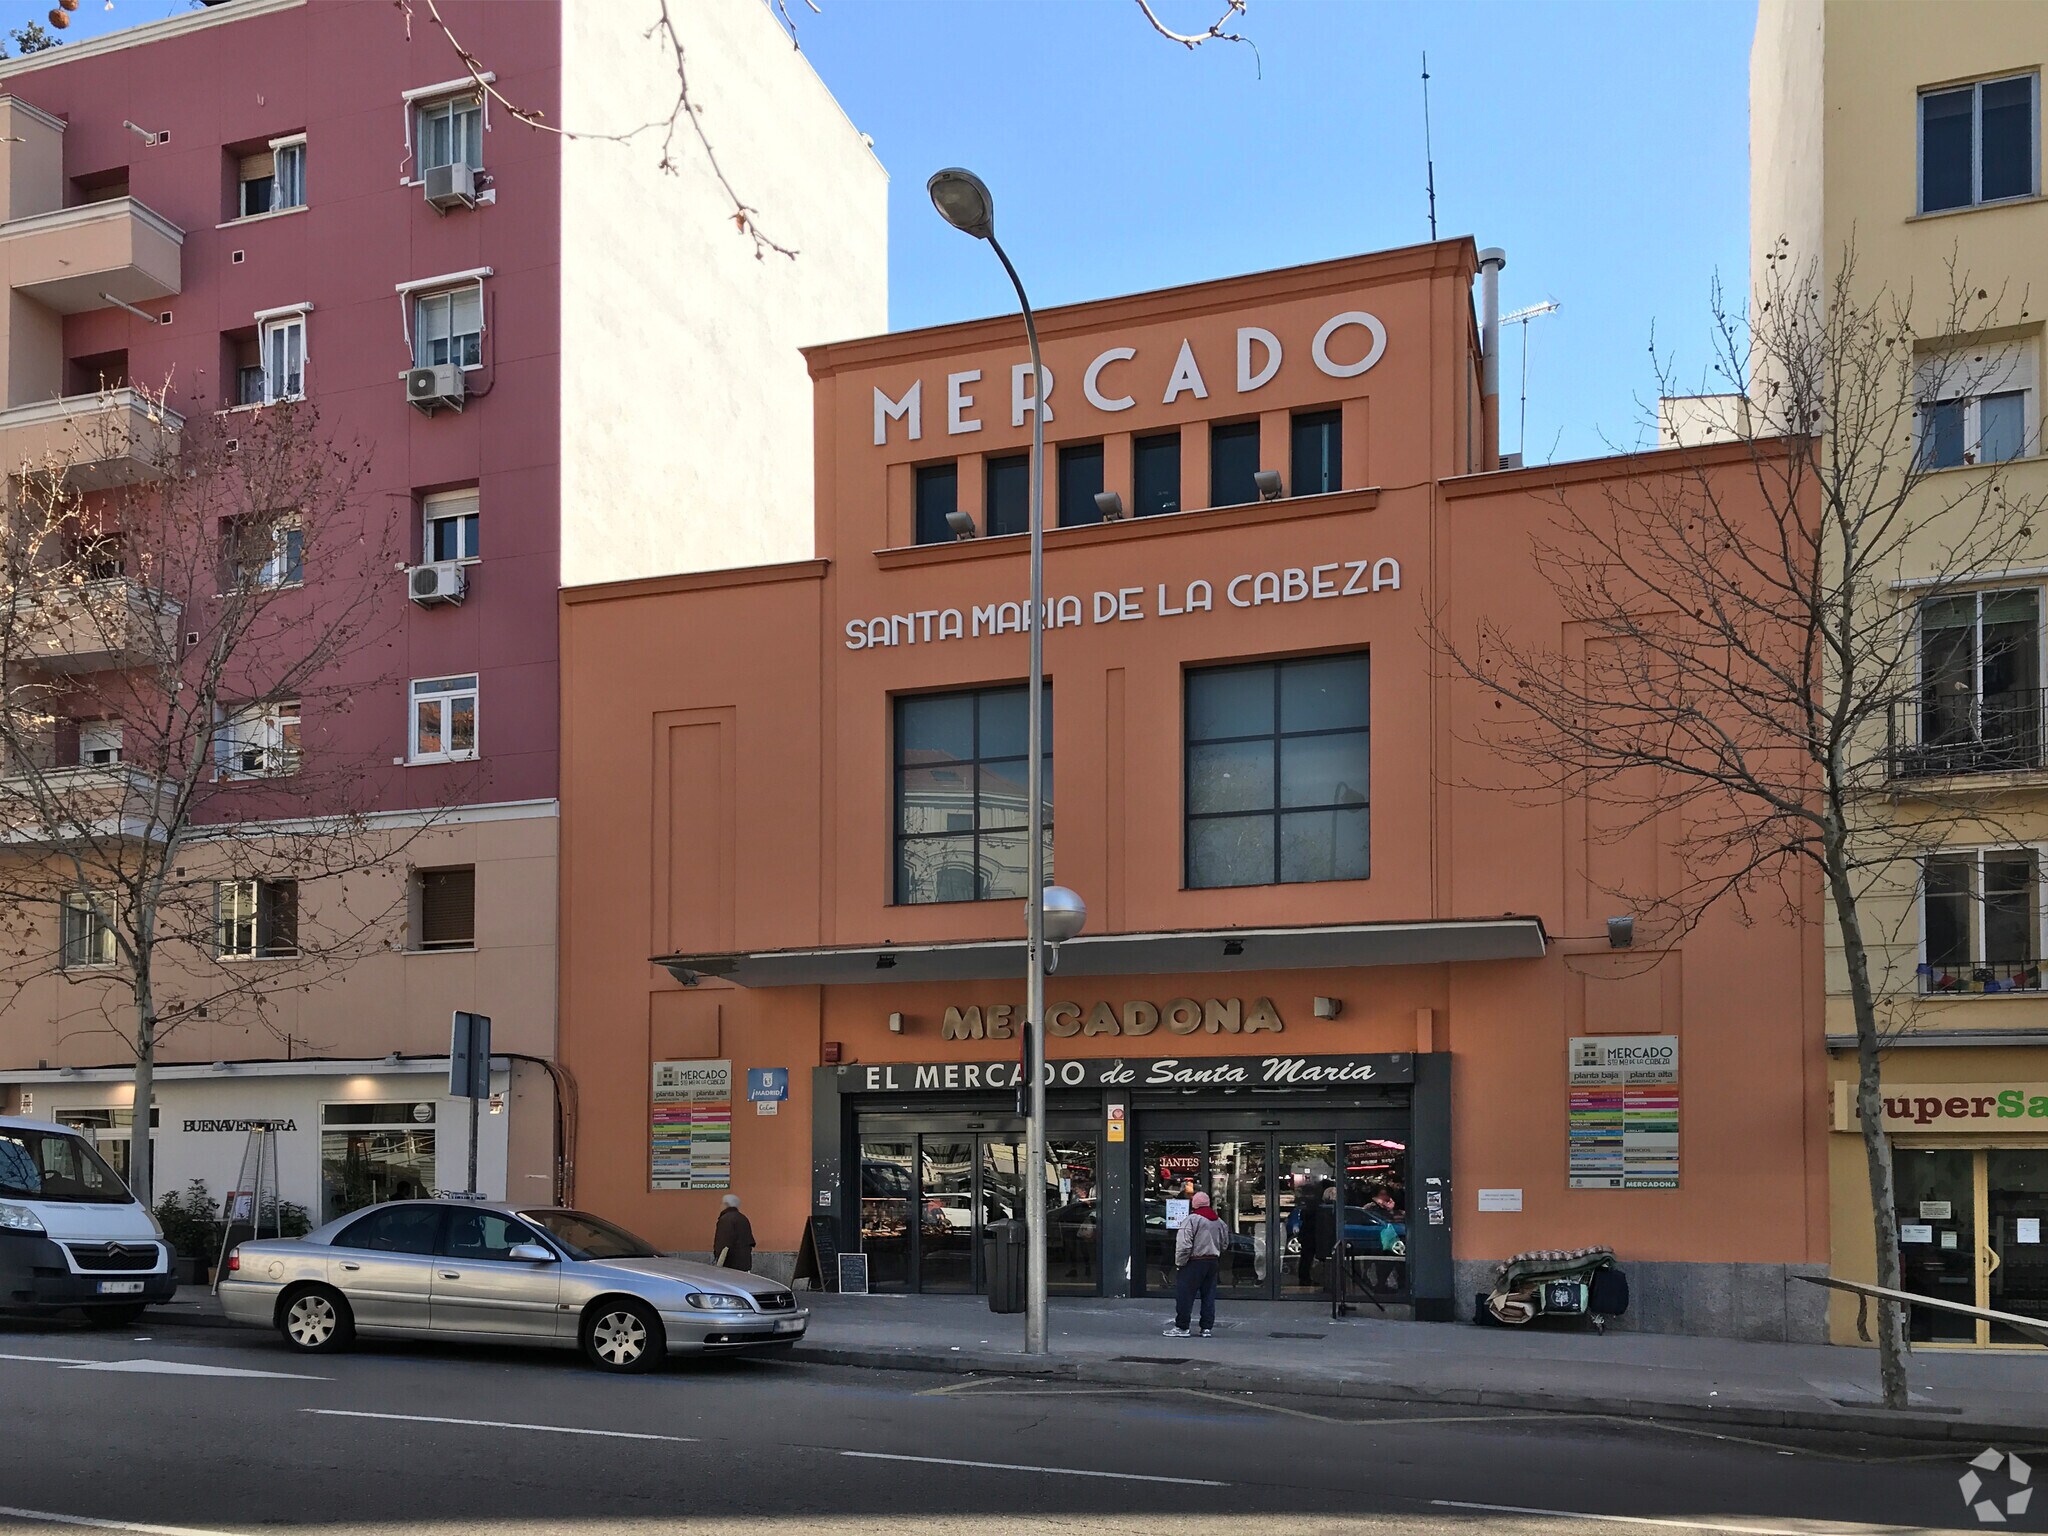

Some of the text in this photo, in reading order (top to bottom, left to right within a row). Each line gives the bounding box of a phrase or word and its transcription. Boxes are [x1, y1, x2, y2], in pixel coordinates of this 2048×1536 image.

[873, 311, 1387, 446] MERCADO
[845, 608, 963, 650] SANTA
[1093, 586, 1145, 624] DE
[1158, 579, 1212, 616] LA
[1226, 556, 1400, 607] CABEZA
[1607, 1046, 1673, 1059] MERCADO
[680, 1069, 728, 1080] MERCADO
[866, 1066, 899, 1090] EL
[1100, 1062, 1135, 1084] de
[1145, 1059, 1248, 1084] Santa
[1261, 1057, 1376, 1083] Maria
[1574, 1072, 1619, 1080] planta baja
[1630, 1071, 1655, 1080] planta
[1856, 1090, 2048, 1124] uperSa
